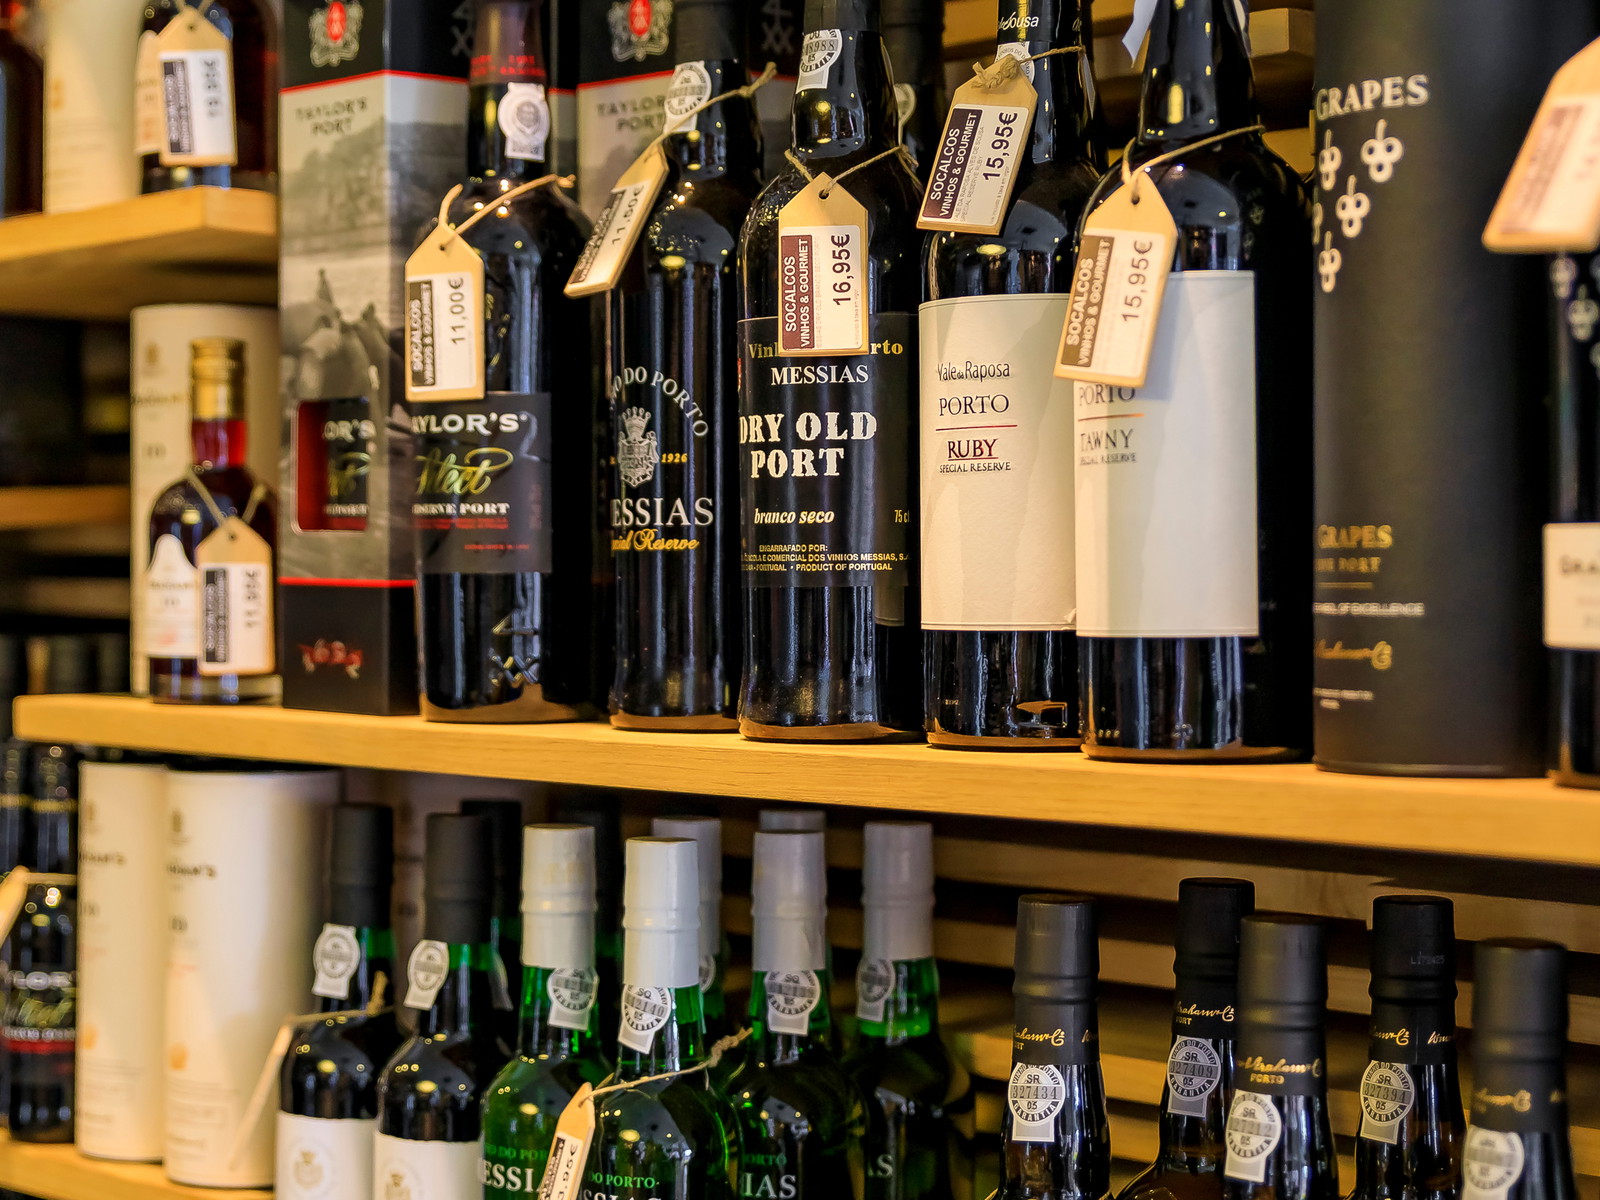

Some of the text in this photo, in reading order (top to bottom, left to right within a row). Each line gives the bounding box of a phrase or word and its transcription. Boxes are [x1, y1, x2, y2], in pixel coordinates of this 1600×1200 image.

[1316, 74, 1429, 120] GRAPES
[983, 112, 1018, 181] 15,95€
[930, 128, 960, 200] SOCALCOS
[940, 112, 977, 216] VINHOS & GOURMET
[831, 234, 854, 306] 16,95€
[1122, 240, 1152, 322] 15,95€
[784, 256, 796, 332] SOCALCOS
[799, 239, 810, 348] VINHOS & GOURMET
[1066, 258, 1094, 346] SOCALCOS
[1078, 317, 1096, 365] VINHOS
[1090, 239, 1110, 304] GOURMET
[448, 277, 466, 345] 11,00€
[750, 340, 903, 358] Vin rto
[771, 365, 869, 385] MESSIAS
[965, 361, 1010, 382] Raposa
[624, 366, 647, 385] DO
[651, 370, 708, 436] PORTO
[939, 394, 1010, 416] PORTO
[740, 412, 878, 444] DRY OLD
[948, 438, 998, 458] RUBY
[1080, 428, 1134, 452] TAWNY
[662, 453, 688, 463] 1926
[751, 448, 844, 478] PORT
[940, 462, 1011, 473] SPECIAL RESERVE
[460, 502, 510, 515] PORT
[610, 497, 714, 527] ESSIAS
[754, 508, 835, 524] branco seco
[894, 510, 903, 523] 75
[633, 528, 699, 550] Reserve
[808, 544, 828, 552] POR:
[767, 554, 807, 562] COMERCIAL
[860, 554, 898, 562] MESSIAS,
[1184, 1052, 1198, 1062] SR
[1026, 1074, 1040, 1084] SR
[1377, 1074, 1392, 1085] SR
[606, 1174, 656, 1188] PORTO
